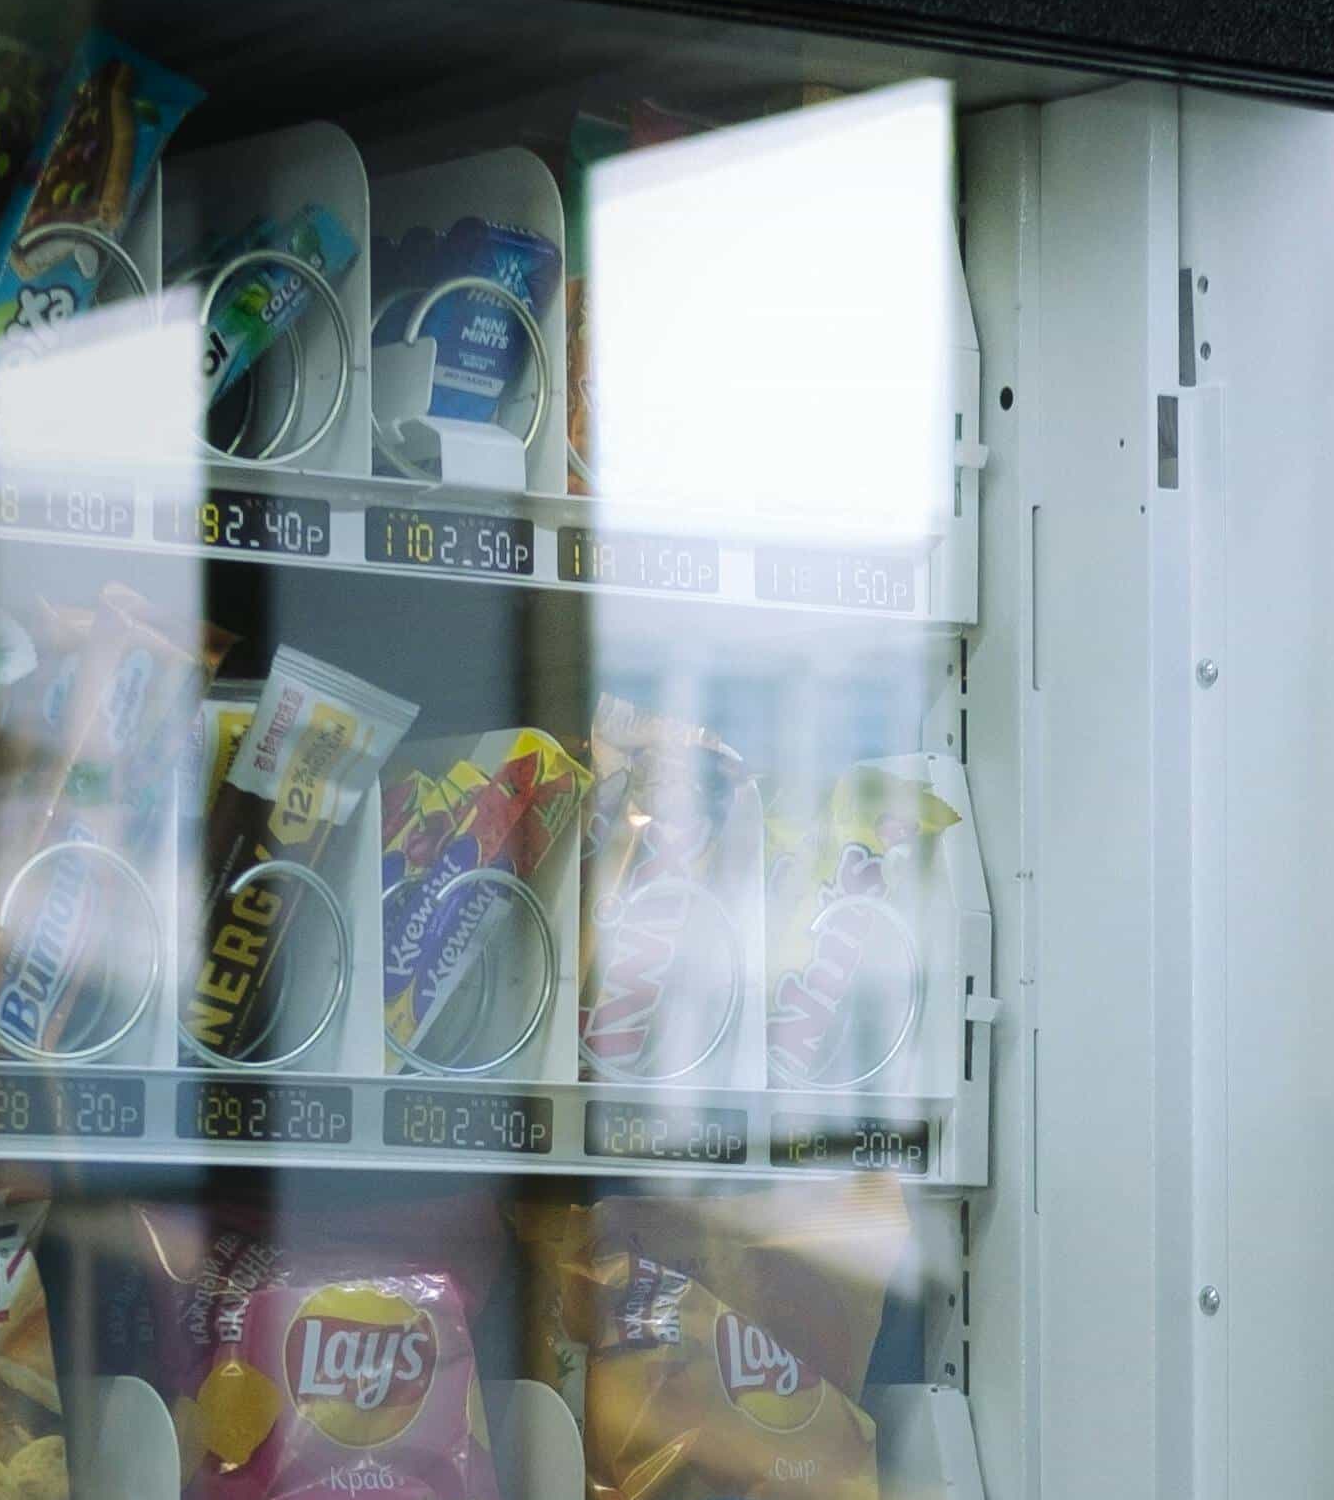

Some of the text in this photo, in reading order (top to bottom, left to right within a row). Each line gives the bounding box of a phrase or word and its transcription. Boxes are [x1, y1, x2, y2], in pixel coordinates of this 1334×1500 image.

[259, 254, 323, 323] COLOS
[298, 1320, 429, 1411] Lay's
[728, 1313, 805, 1397] Lay
